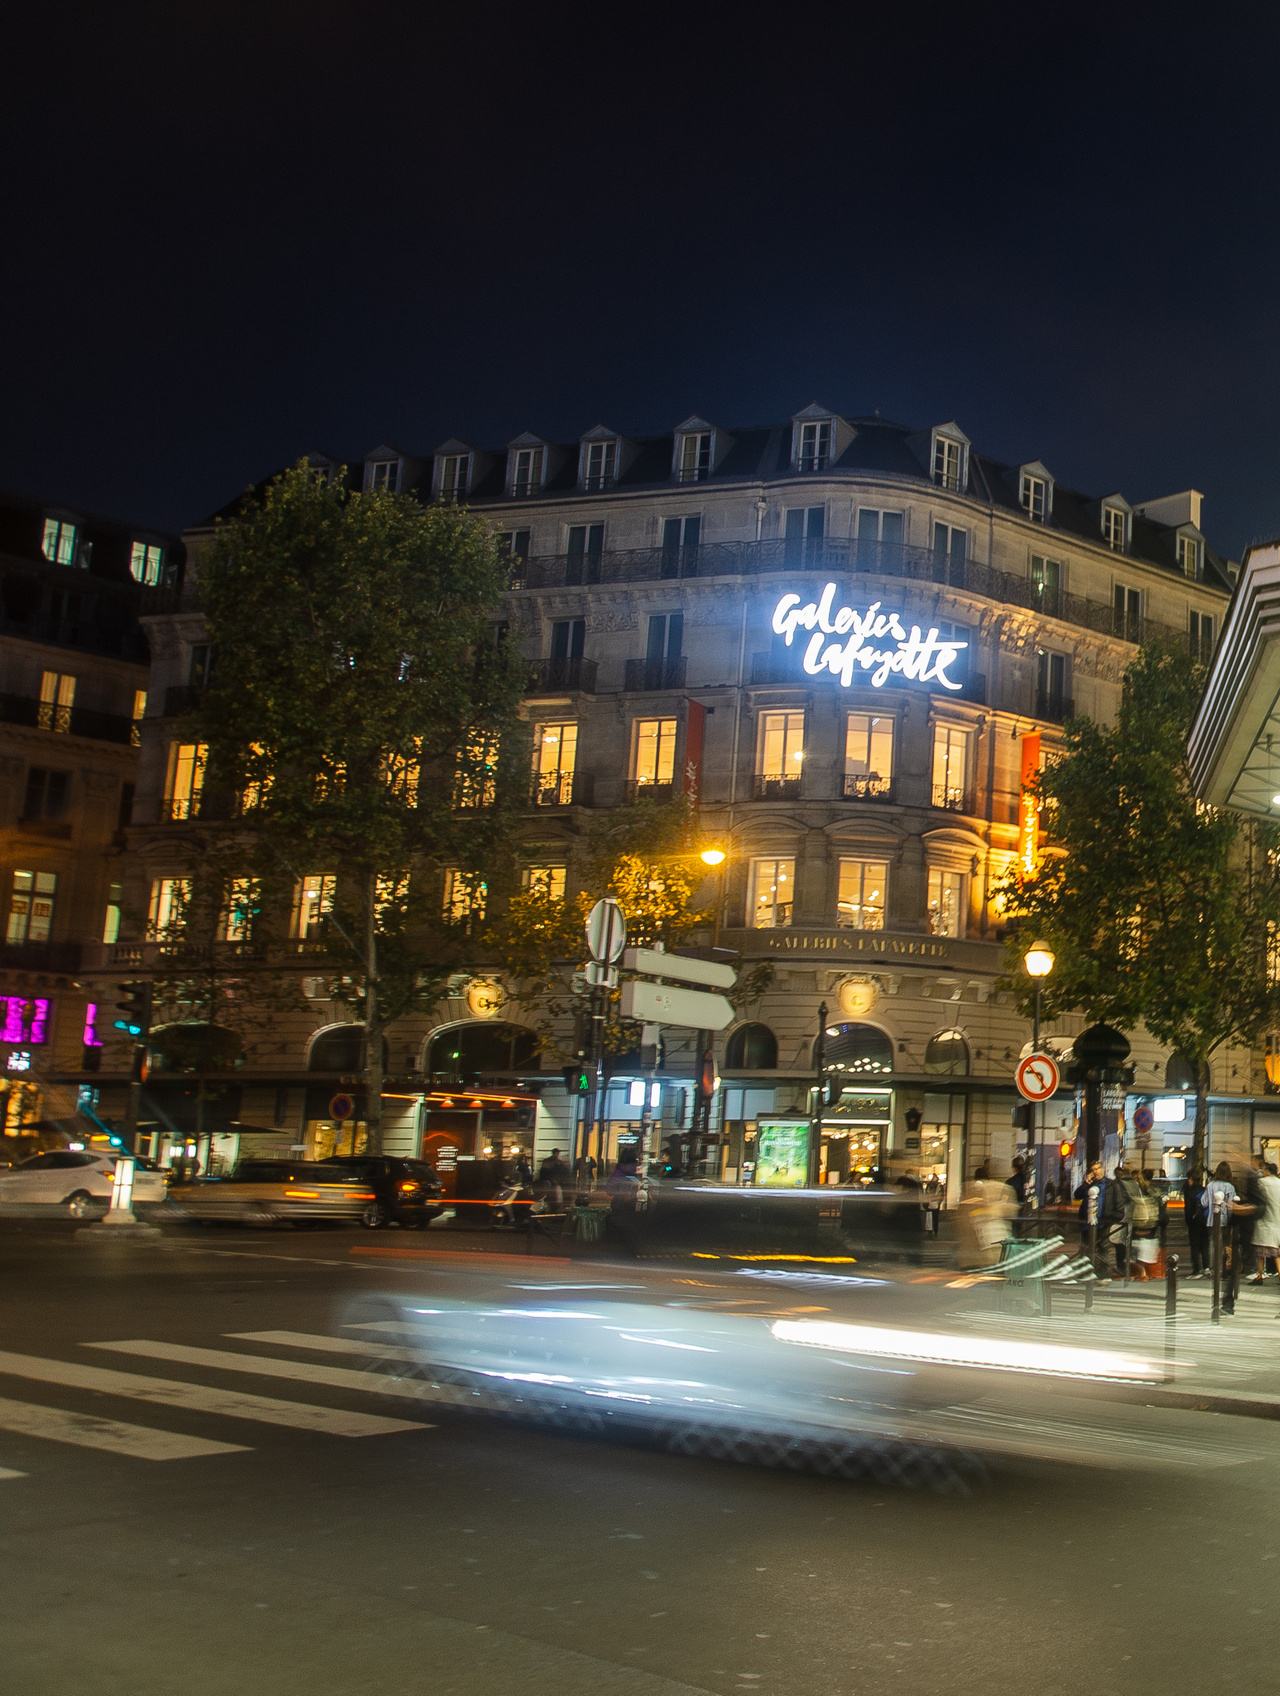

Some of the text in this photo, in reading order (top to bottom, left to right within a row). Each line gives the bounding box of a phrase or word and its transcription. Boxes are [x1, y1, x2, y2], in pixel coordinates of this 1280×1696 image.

[771, 582, 907, 647] Galeries
[802, 625, 969, 690] Lafayette
[769, 937, 949, 958] GALERIES LAFAYETTE
